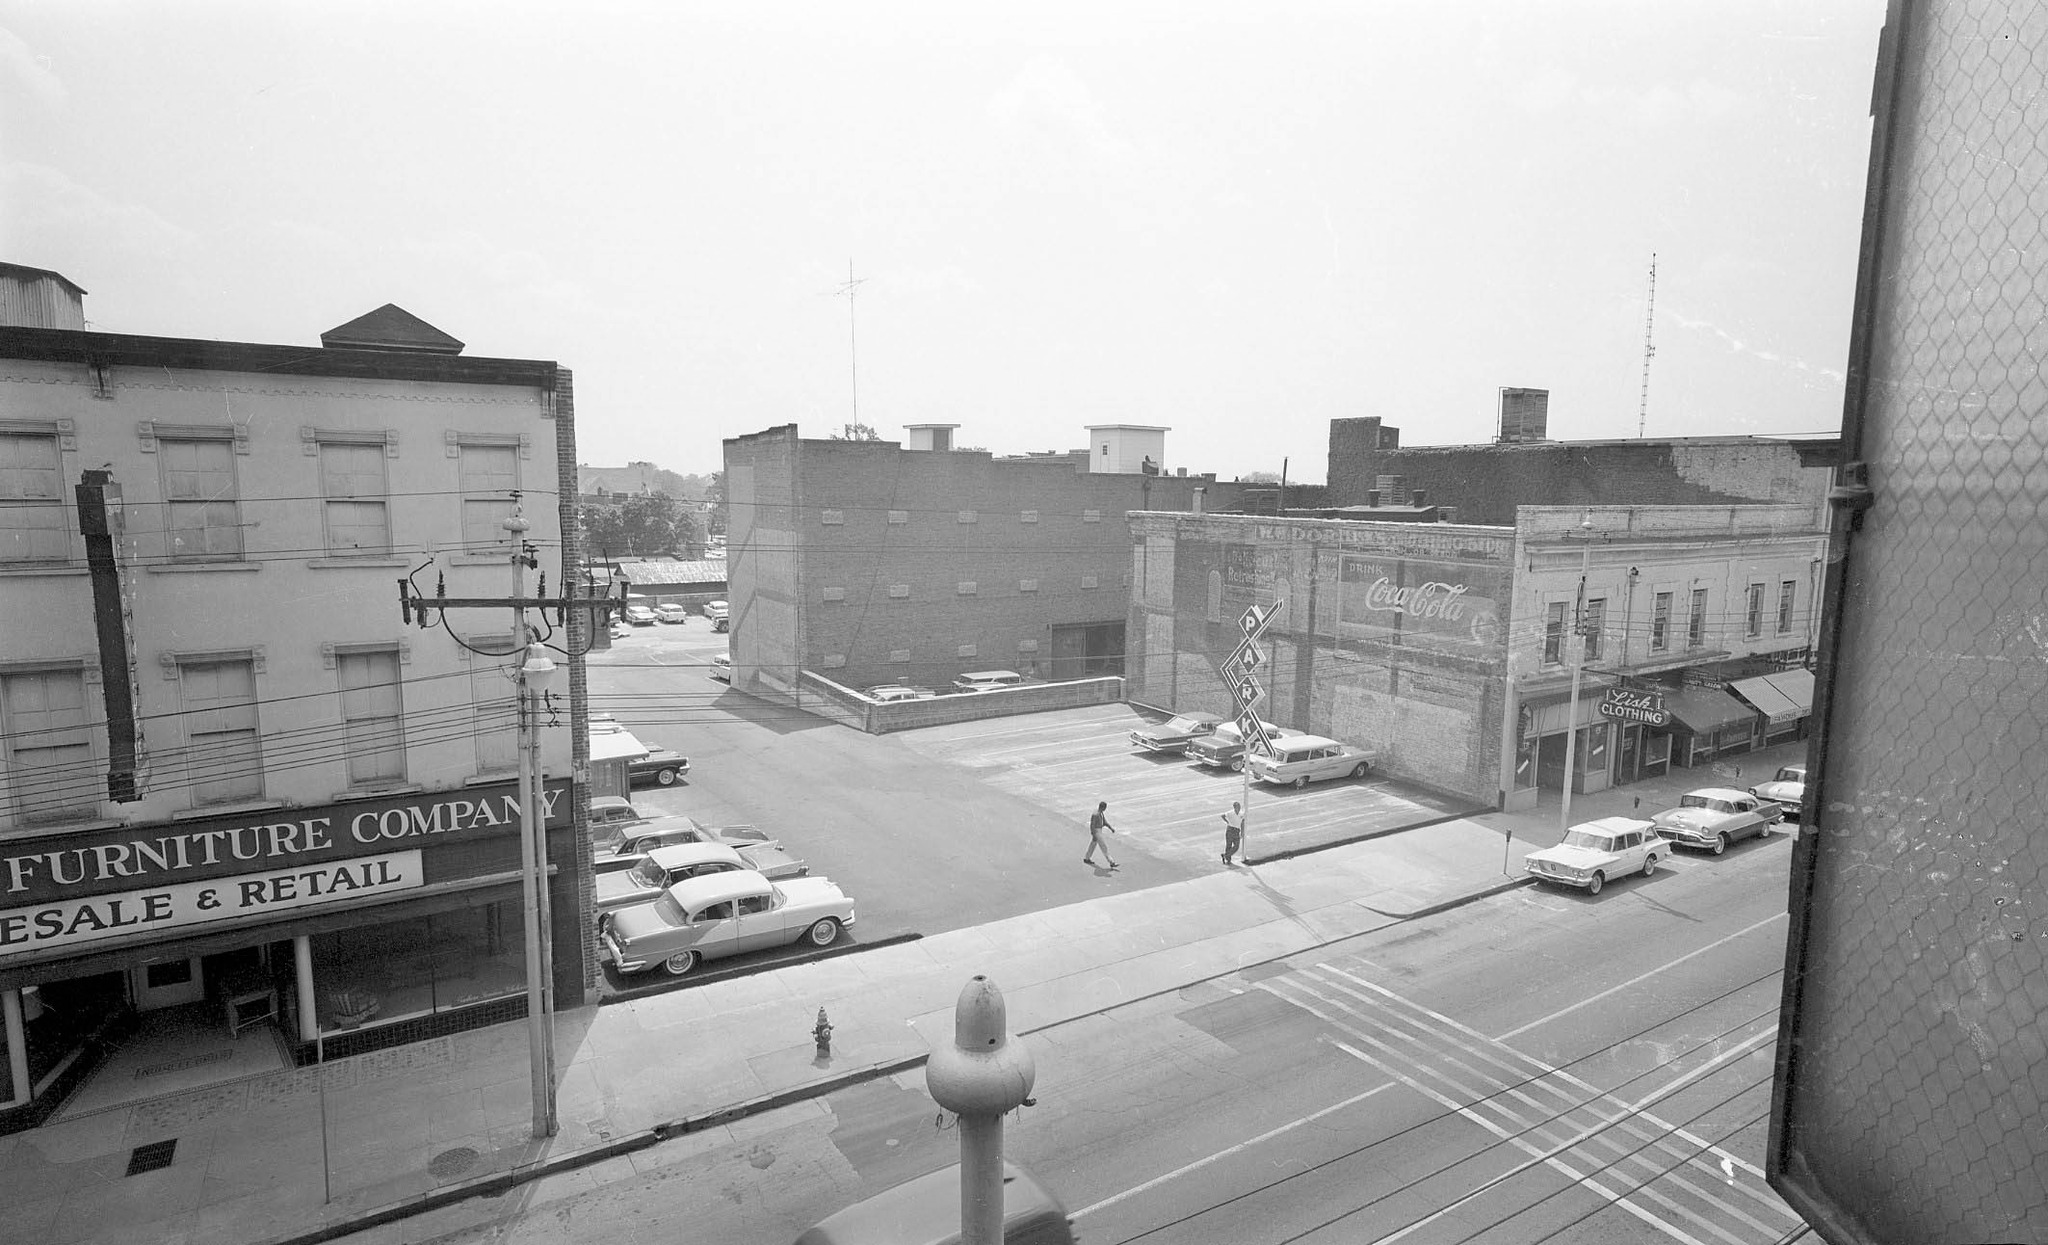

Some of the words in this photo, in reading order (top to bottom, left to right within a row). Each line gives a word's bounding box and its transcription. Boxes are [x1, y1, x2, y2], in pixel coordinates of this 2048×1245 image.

[1349, 563, 1384, 576] DRINK
[1240, 615, 1257, 734] PARK
[1601, 703, 1662, 723] CLOTHING
[4, 817, 332, 893] FURNITURE
[352, 789, 565, 843] COMPANY
[0, 893, 172, 945] ESALE
[198, 888, 222, 910] &
[239, 860, 401, 908] RETAIL
